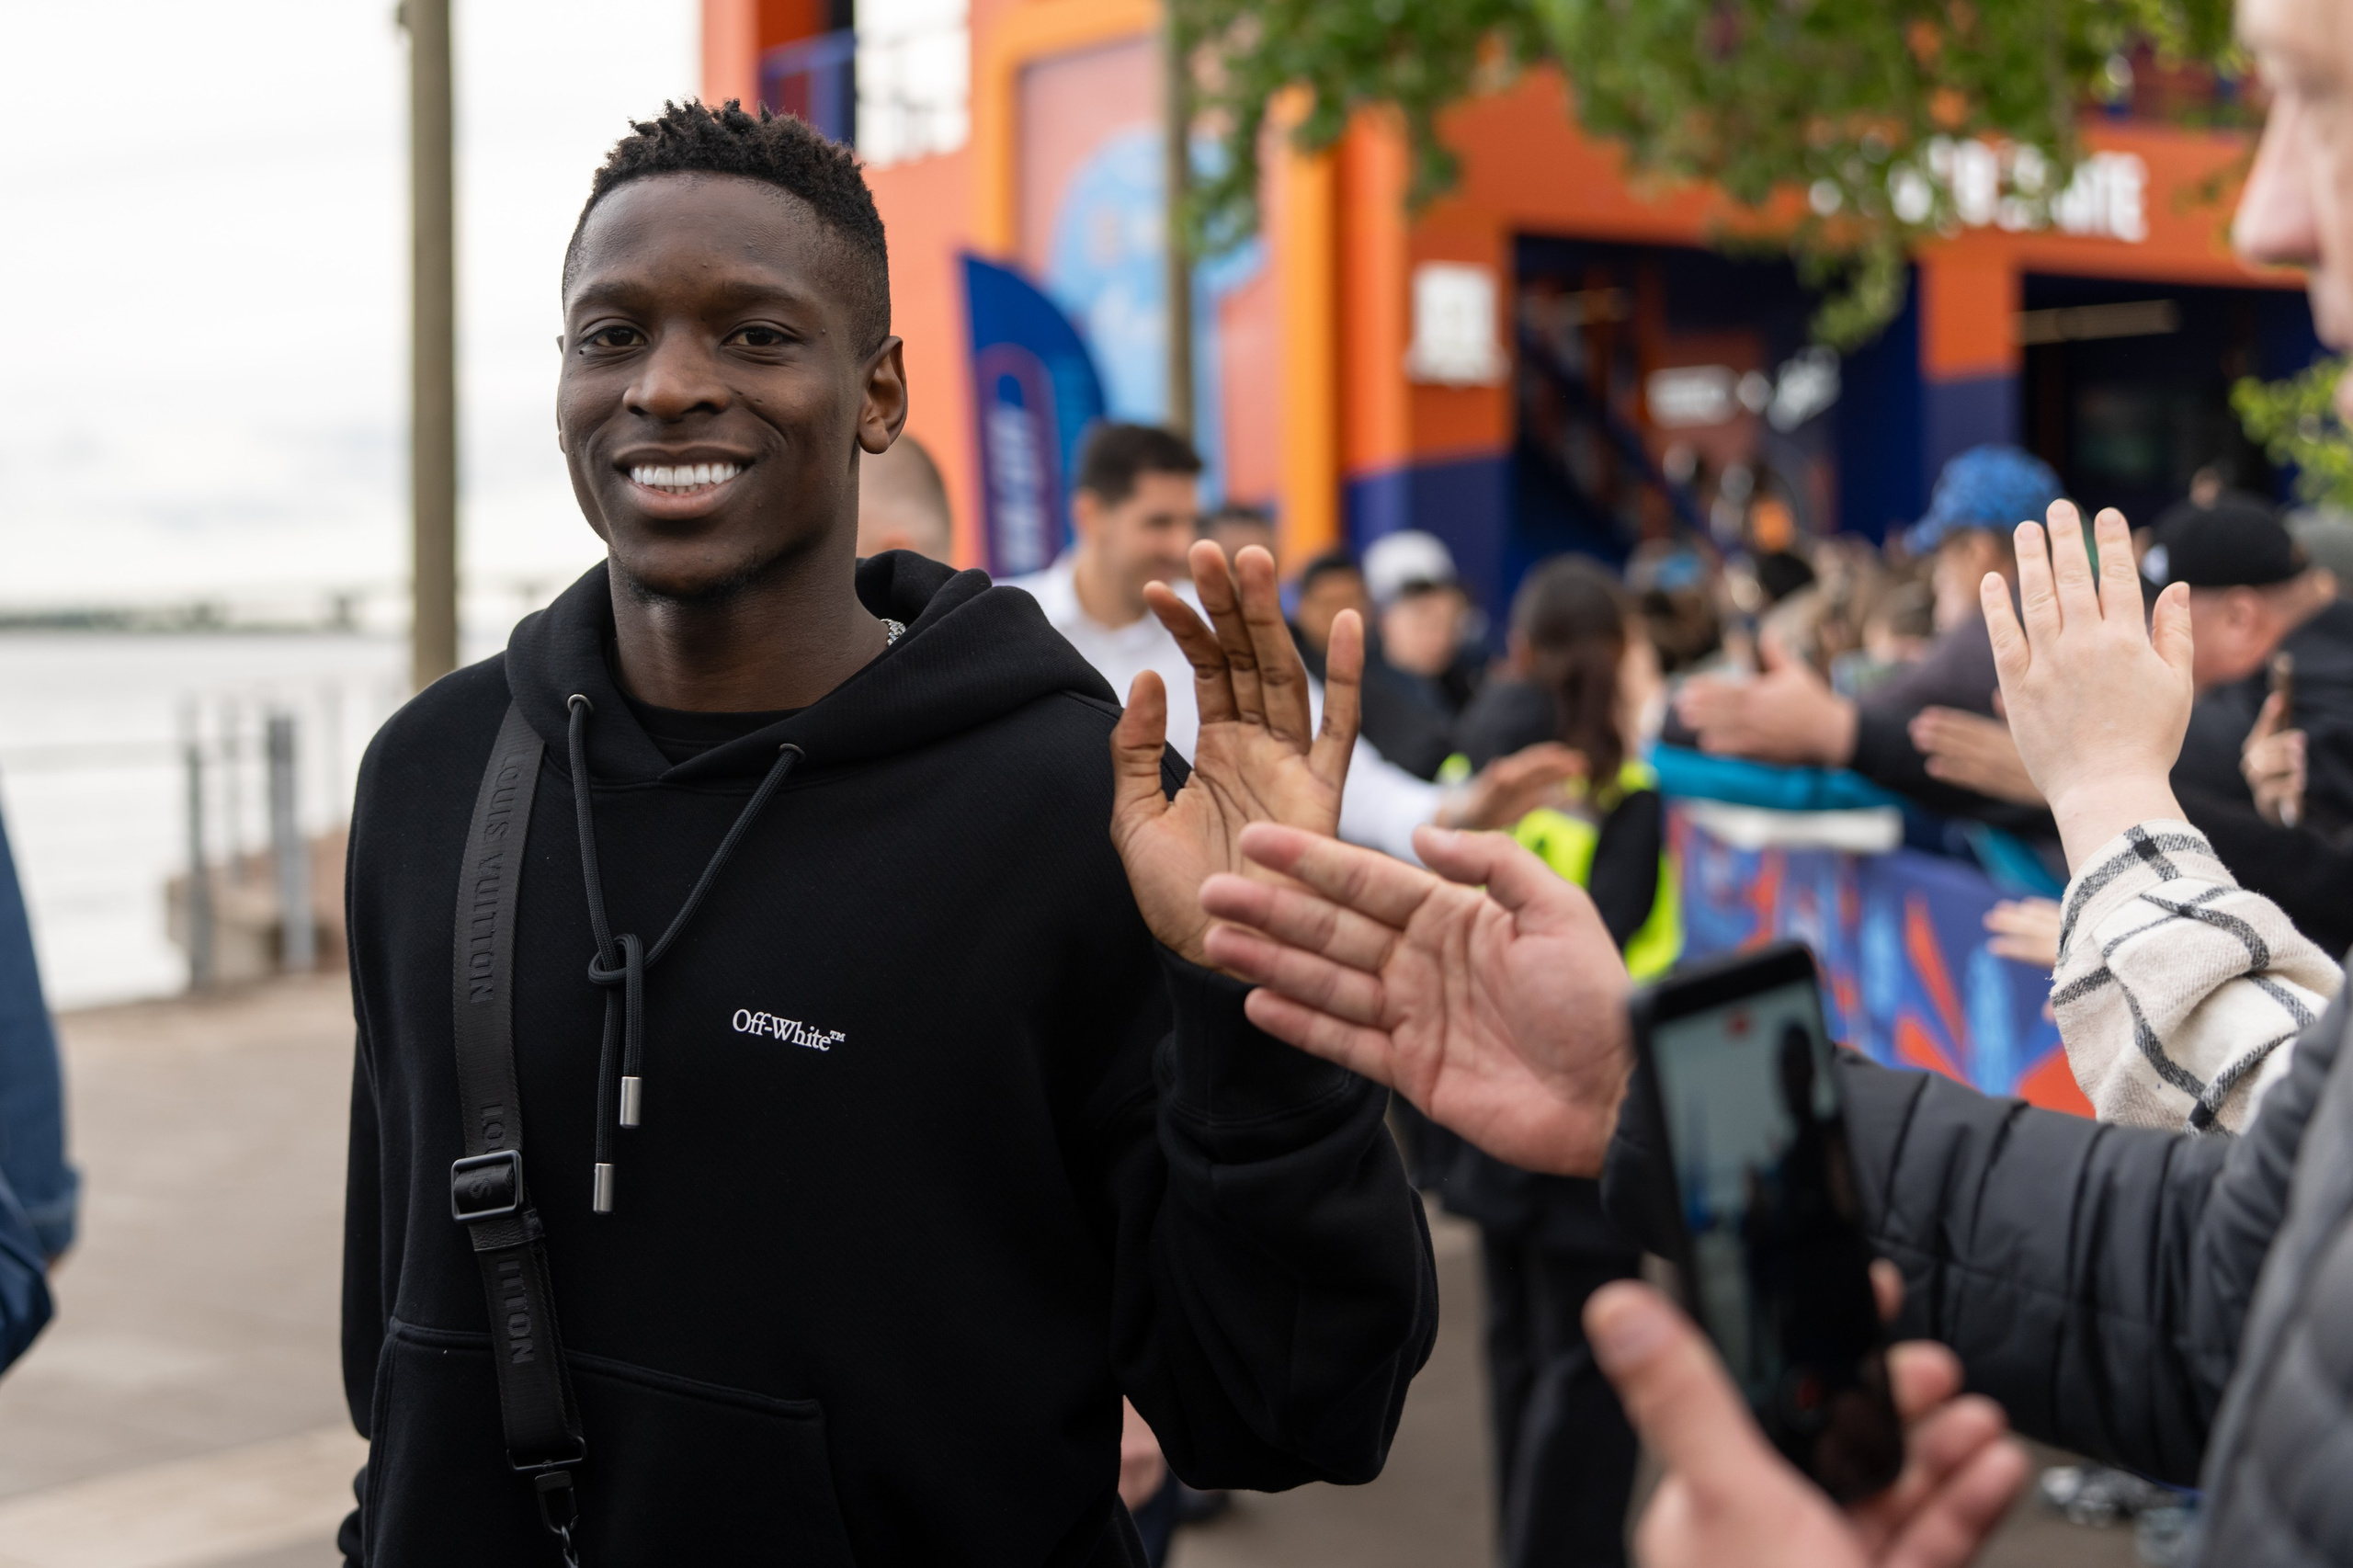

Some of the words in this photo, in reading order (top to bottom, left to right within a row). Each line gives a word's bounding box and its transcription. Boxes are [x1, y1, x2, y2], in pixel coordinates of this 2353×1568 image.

[483, 750, 528, 842] LOUIS
[469, 854, 504, 1005] VUITTON
[497, 1256, 537, 1364] ITTON
